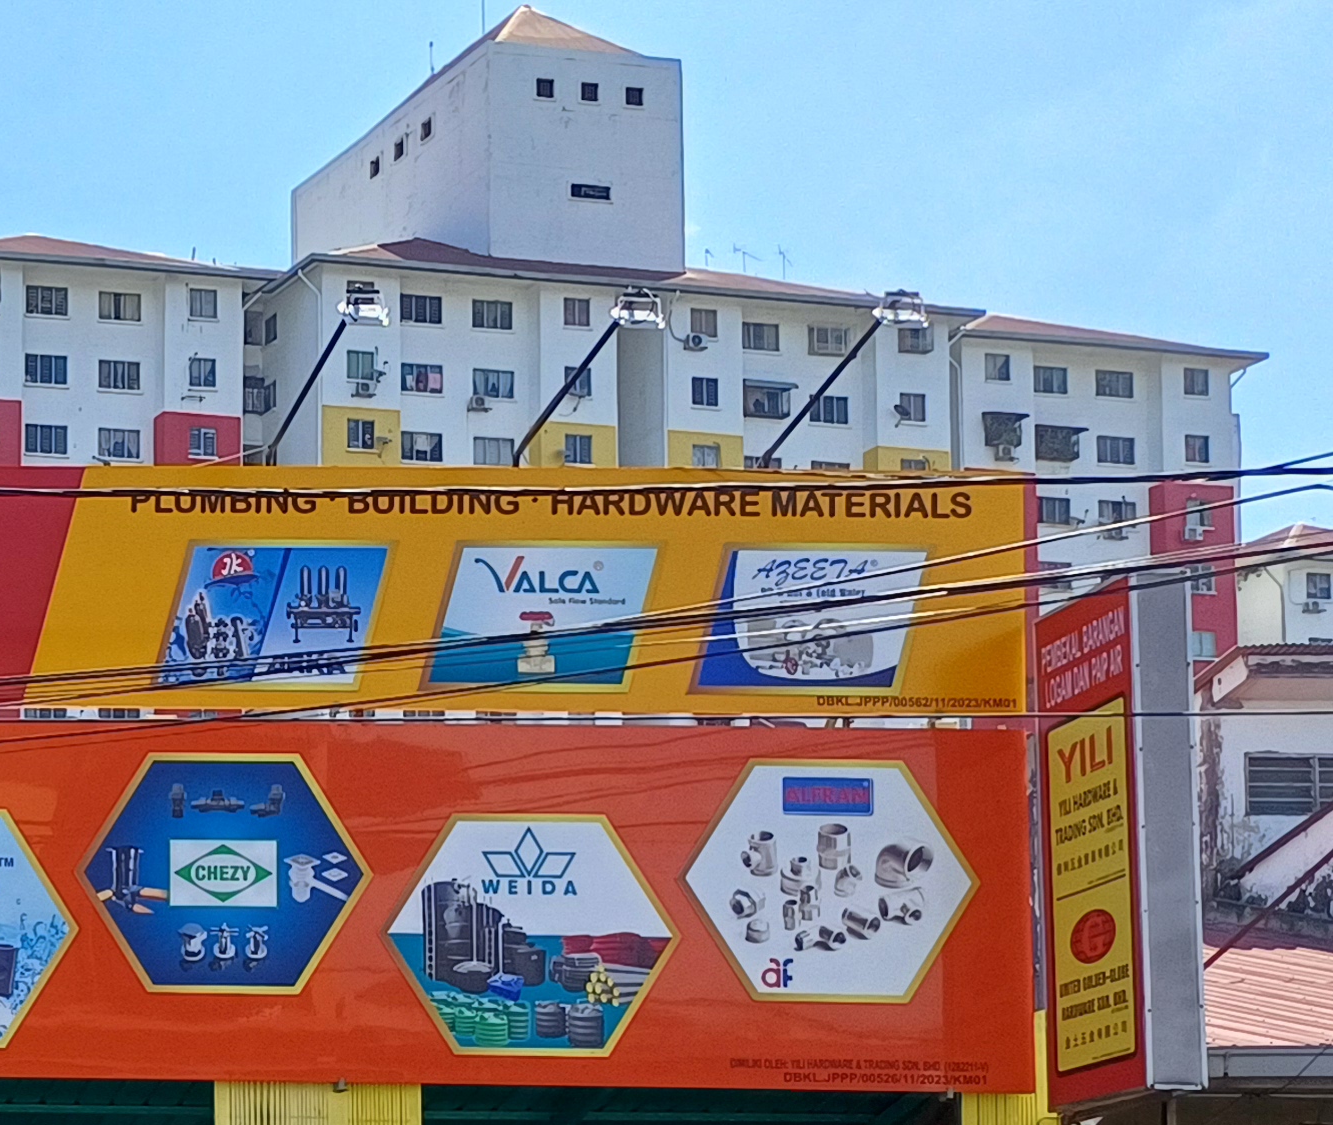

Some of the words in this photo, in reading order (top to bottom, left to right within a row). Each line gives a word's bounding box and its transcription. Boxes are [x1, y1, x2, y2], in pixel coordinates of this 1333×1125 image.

[130, 490, 317, 515] PLUMBING
[347, 490, 520, 515] BUILDING
[551, 490, 761, 518] HARDWARE
[771, 491, 973, 520] MATERIALS
[474, 555, 600, 593] VALCA
[1056, 725, 1113, 784] YILI
[194, 865, 251, 881] CHEZY
[481, 879, 578, 896] WEIDA
